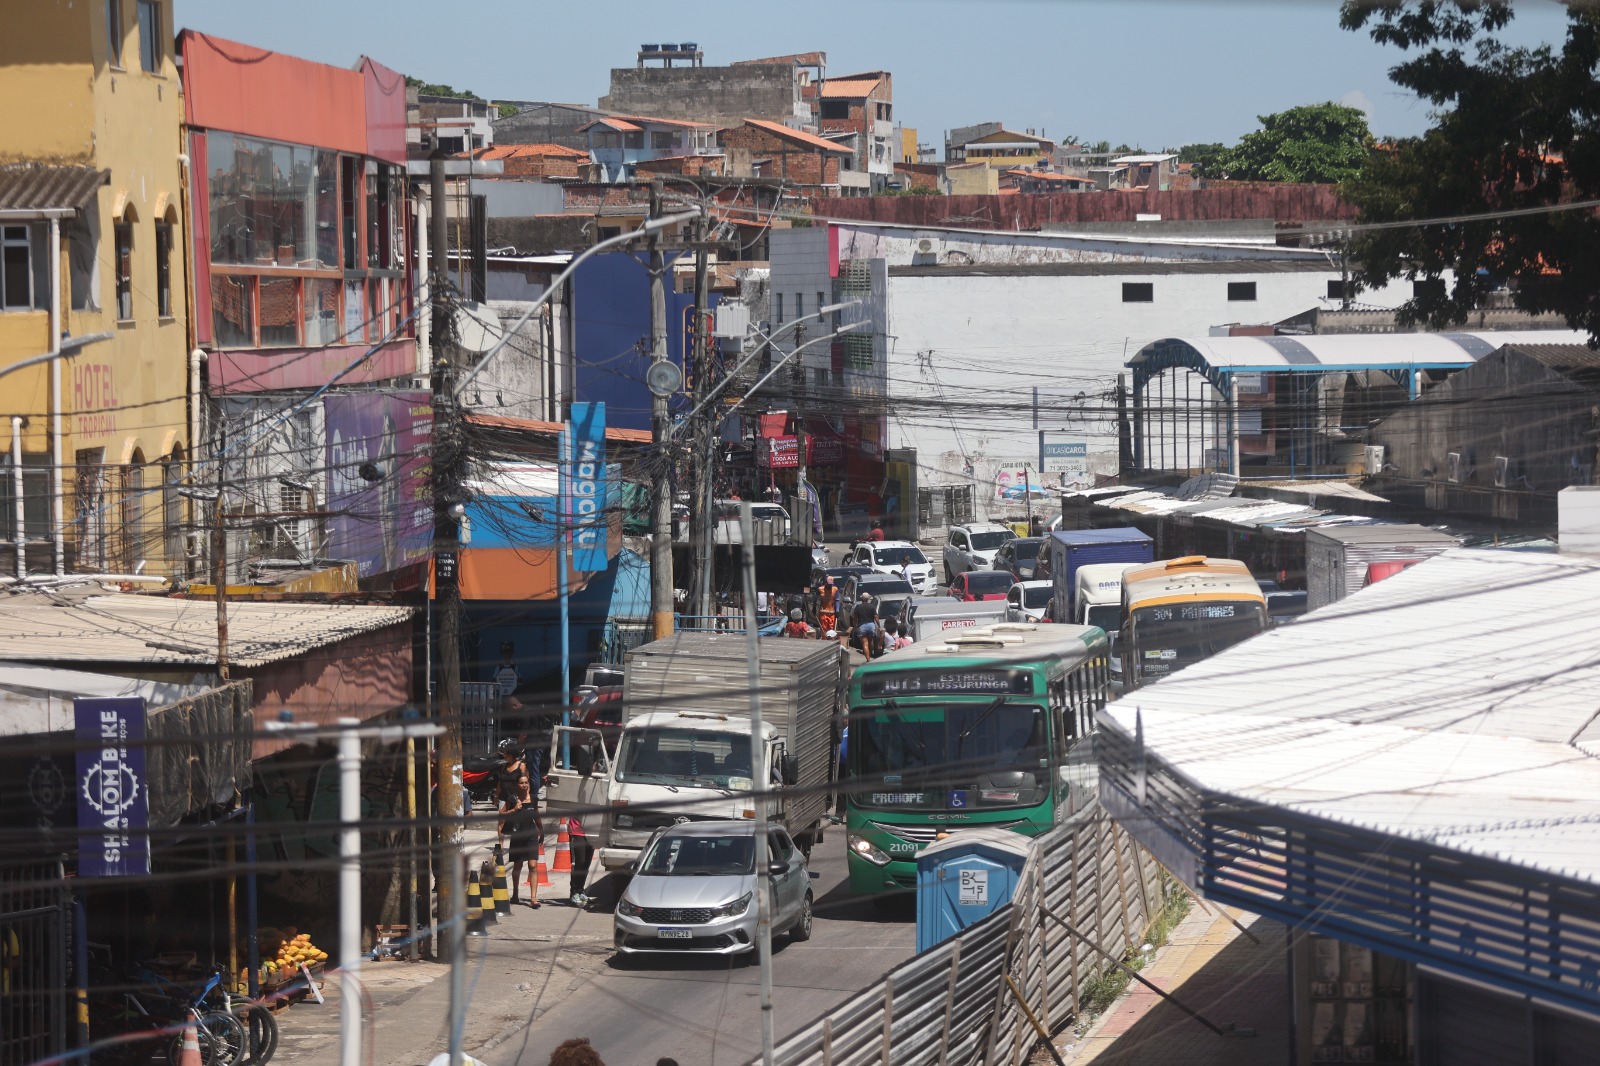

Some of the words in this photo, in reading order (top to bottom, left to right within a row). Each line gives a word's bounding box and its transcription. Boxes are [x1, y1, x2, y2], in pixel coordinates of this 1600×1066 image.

[74, 363, 118, 411] HOTEL
[1065, 445, 1086, 454] CAROL
[942, 620, 975, 629] CARRETO
[927, 680, 1009, 690] MUSSURUNGA
[102, 769, 121, 863] SHALOM
[890, 843, 919, 853] 21091
